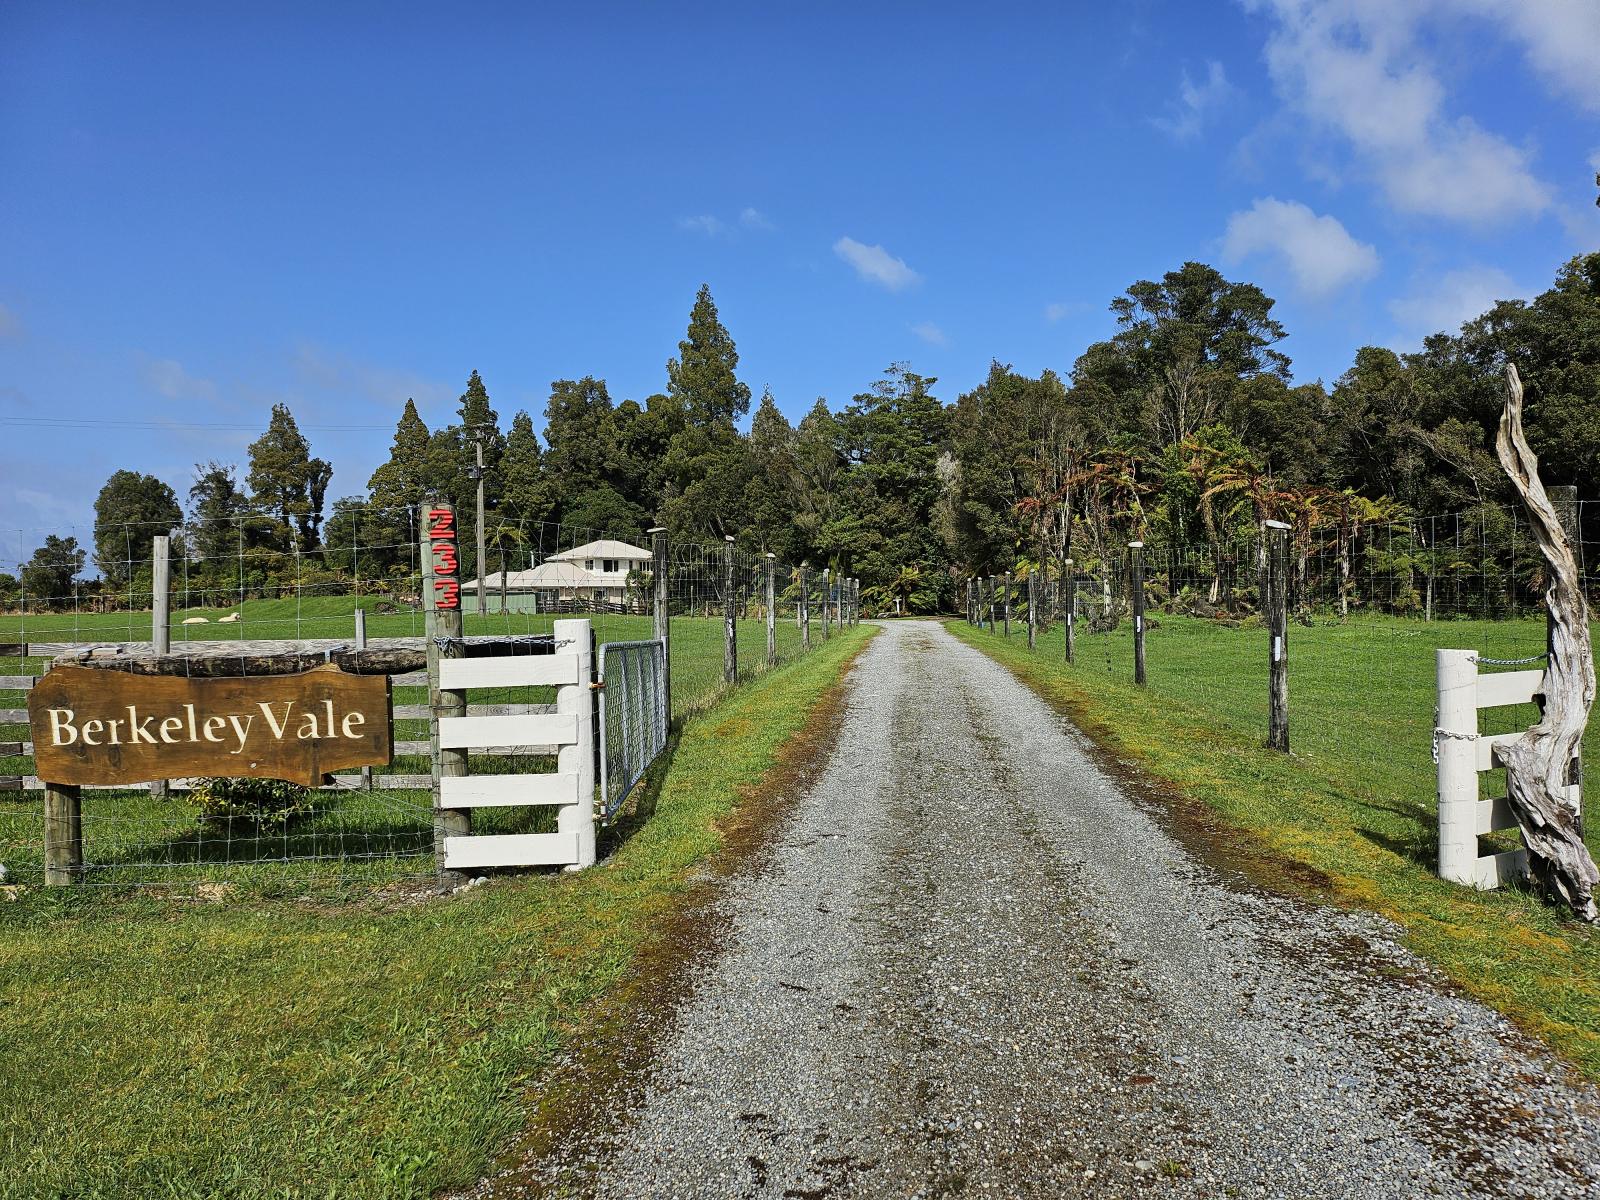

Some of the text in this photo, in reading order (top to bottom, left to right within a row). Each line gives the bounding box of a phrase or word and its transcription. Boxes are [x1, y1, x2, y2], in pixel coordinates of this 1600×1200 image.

[428, 508, 459, 609] 233
[47, 700, 365, 754] Berkeley Vale
